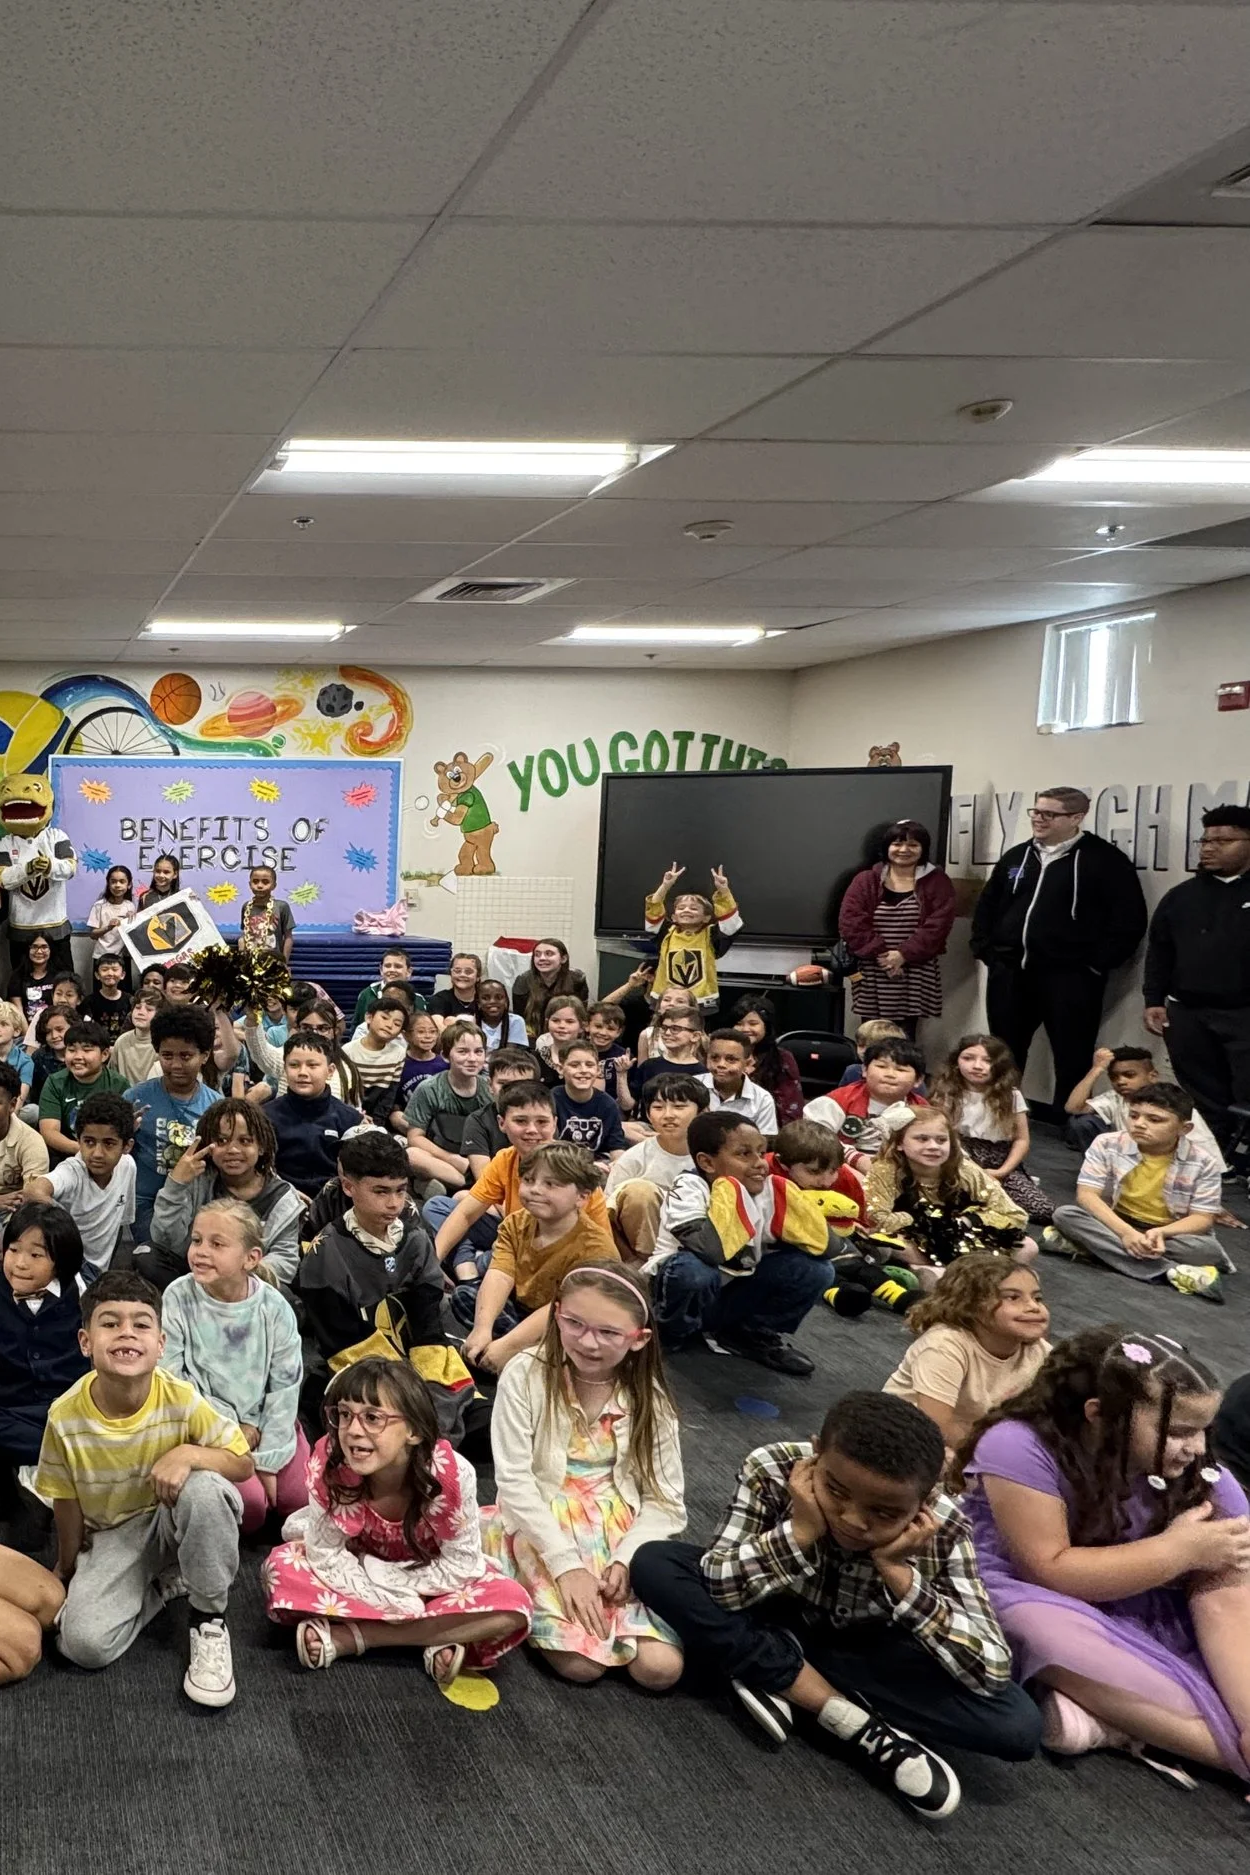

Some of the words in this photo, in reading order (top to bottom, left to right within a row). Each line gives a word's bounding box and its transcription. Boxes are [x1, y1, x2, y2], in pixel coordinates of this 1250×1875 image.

[507, 737, 601, 812] YOU
[609, 730, 695, 772] GOT
[120, 815, 270, 842] BENEFITS
[291, 816, 330, 843] OF
[949, 790, 1024, 865] FLY
